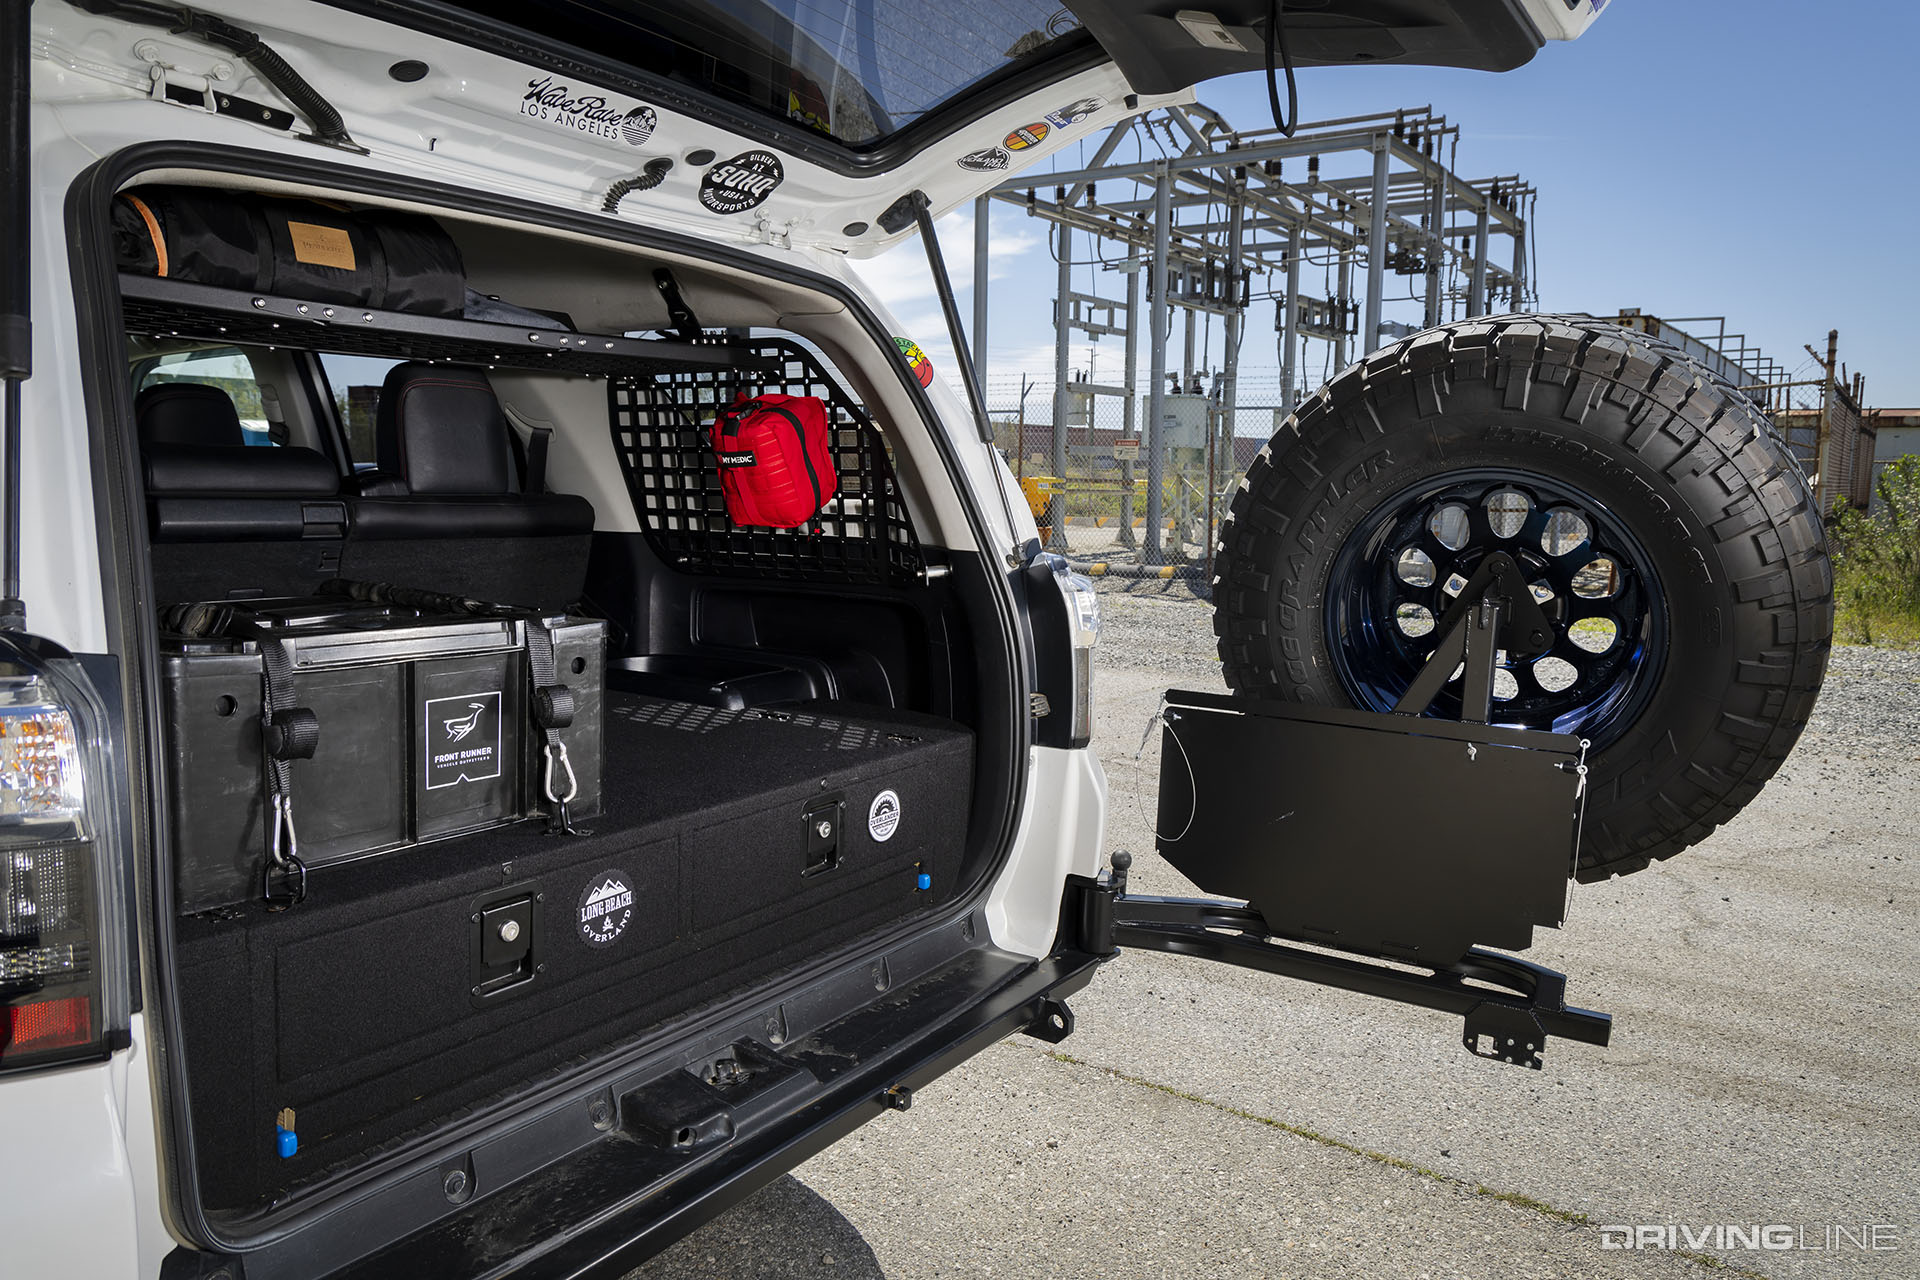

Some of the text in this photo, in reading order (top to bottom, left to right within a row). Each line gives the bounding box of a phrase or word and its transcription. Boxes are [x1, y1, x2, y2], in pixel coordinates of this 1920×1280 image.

[524, 76, 623, 126] Wave Rave
[520, 101, 619, 140] LOS ANGELES
[749, 154, 776, 167] GILBERT
[751, 163, 765, 172] AZ
[703, 187, 756, 212] MOTORSPORTS
[722, 455, 753, 464] MY MEDIC
[434, 746, 492, 764] FRONT RUNNER
[580, 890, 632, 922] LONG BEACH
[583, 909, 631, 943] OVERLAND
